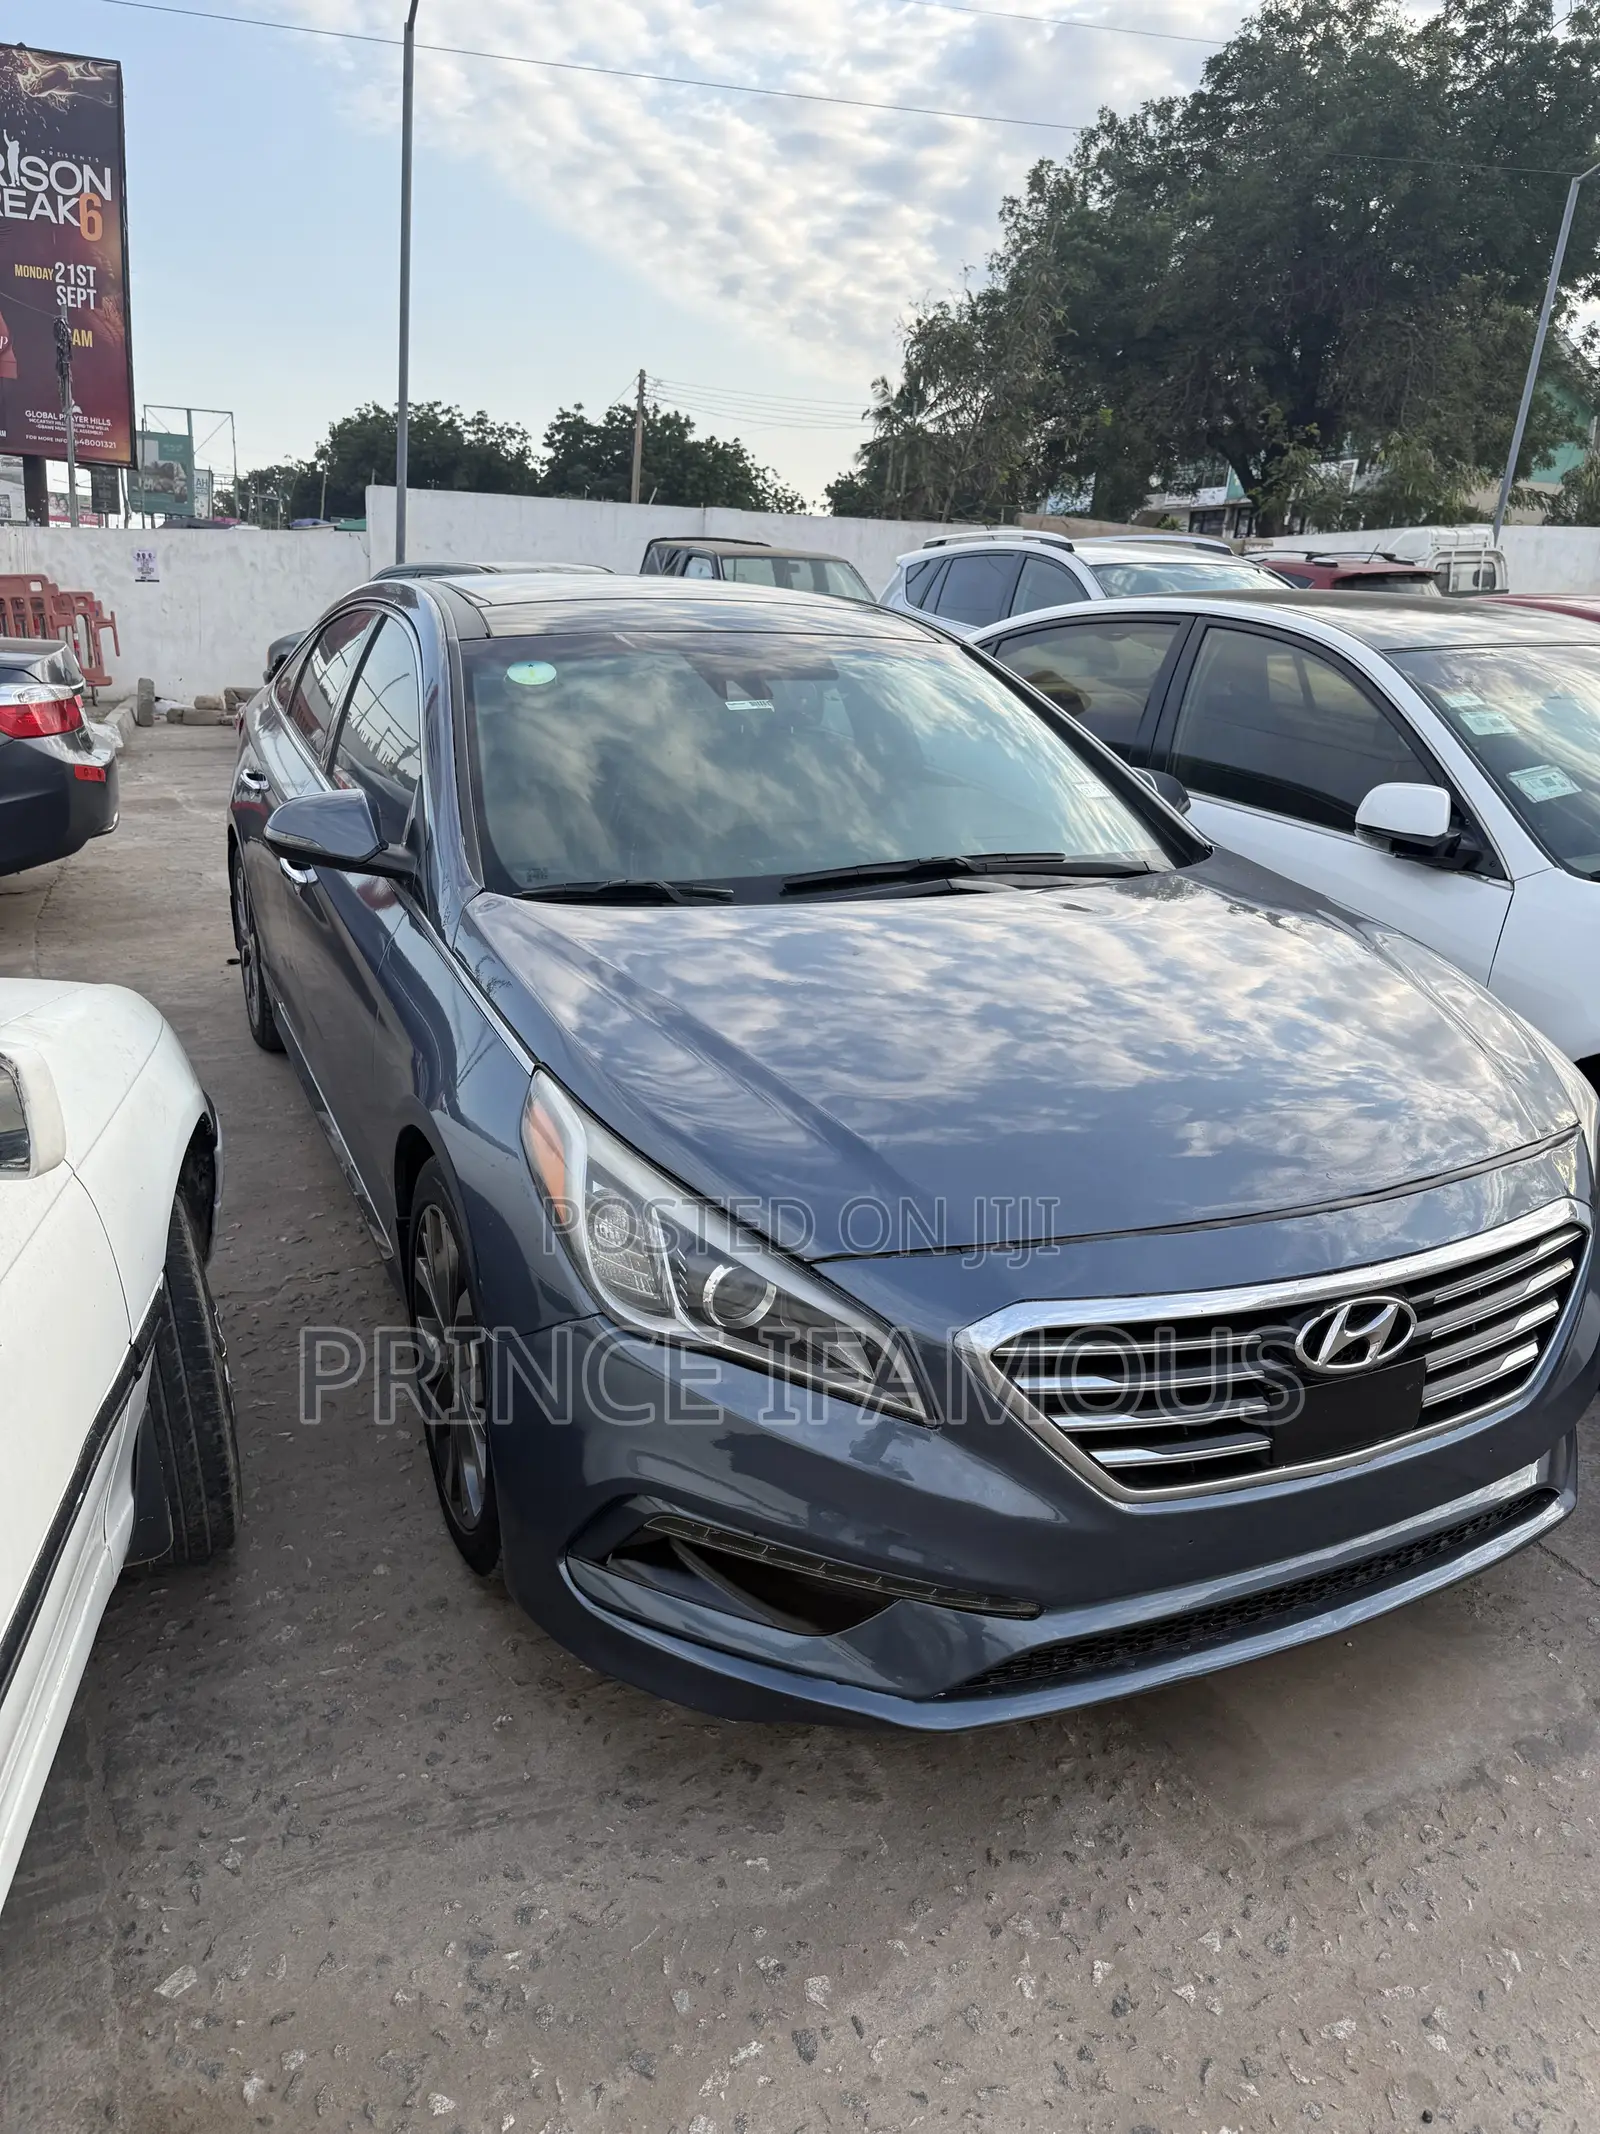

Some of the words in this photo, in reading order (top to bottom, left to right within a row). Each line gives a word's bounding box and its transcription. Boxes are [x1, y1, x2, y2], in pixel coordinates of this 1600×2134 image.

[0, 188, 81, 227] EAK
[14, 263, 54, 281] MONDAY
[54, 261, 97, 287] 21ST
[56, 284, 97, 310] SEPT
[25, 410, 58, 421] GLOBAL
